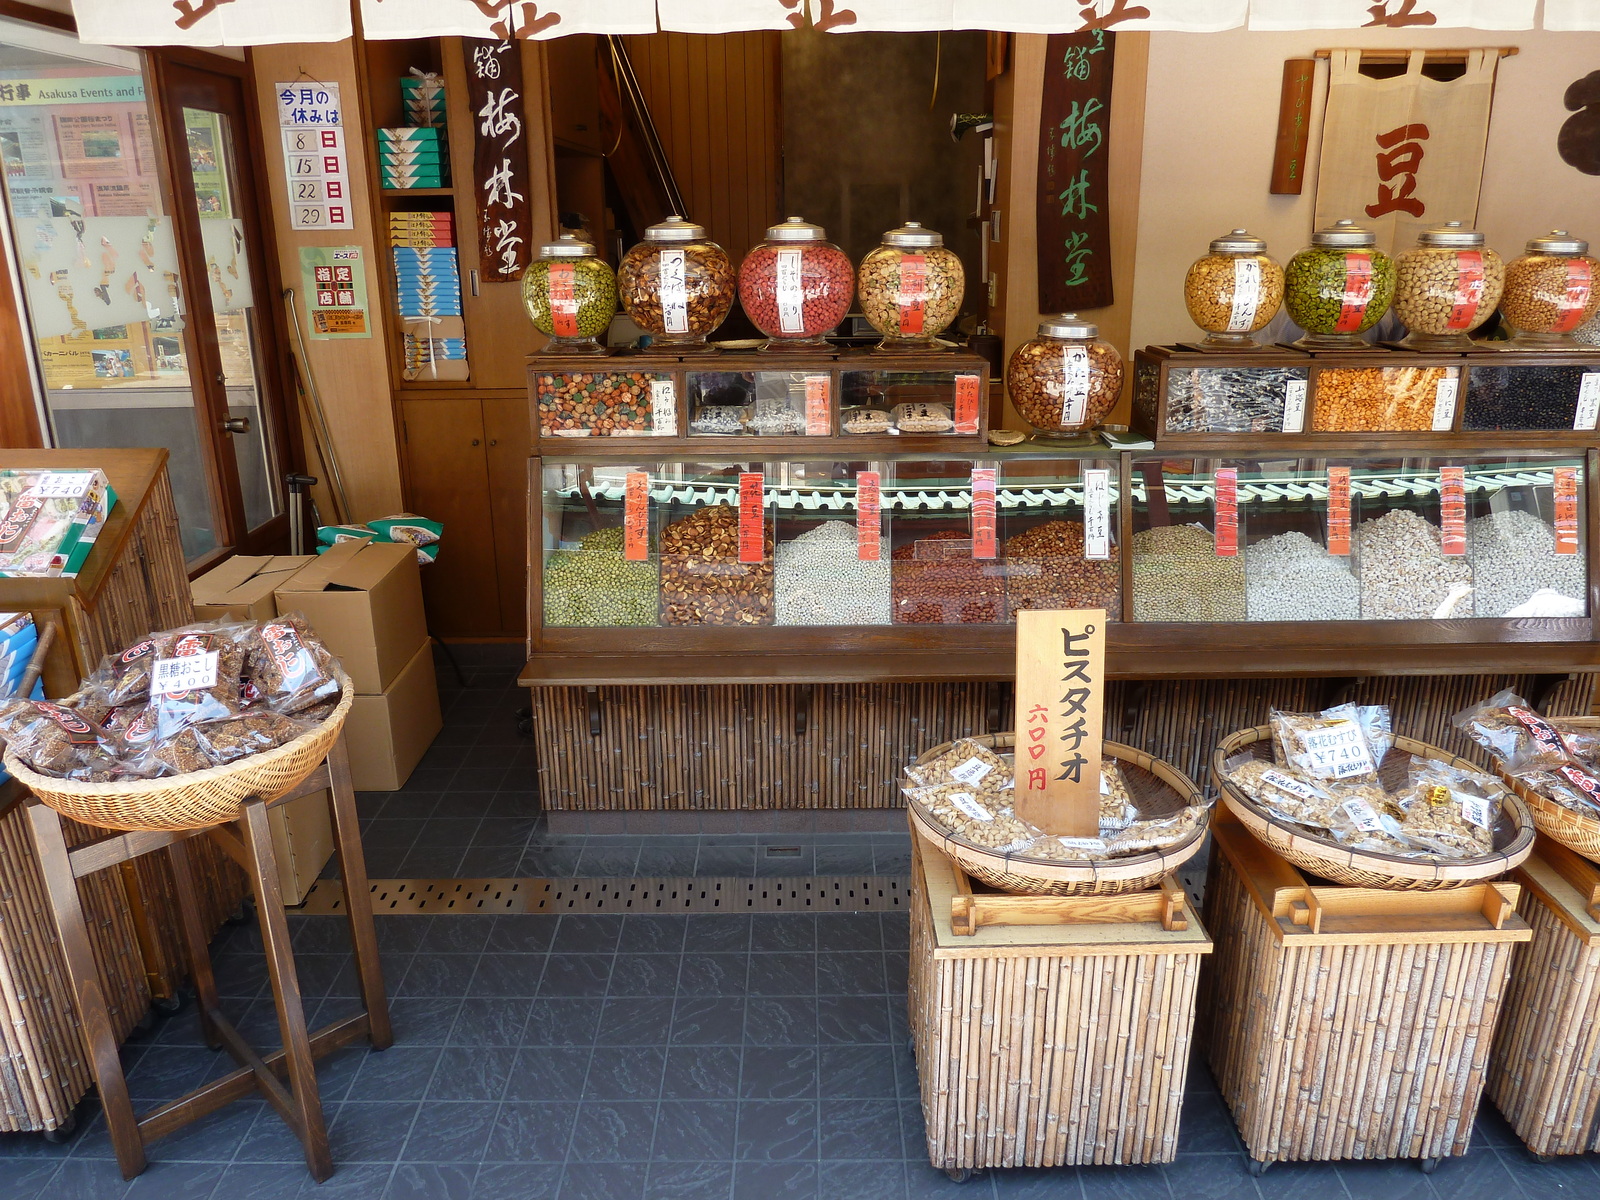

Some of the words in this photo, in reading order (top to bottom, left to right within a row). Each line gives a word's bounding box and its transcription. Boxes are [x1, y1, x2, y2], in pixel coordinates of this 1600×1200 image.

[38, 89, 78, 99] Asakusa
[80, 87, 113, 98] Events
[116, 86, 135, 97] and
[280, 89, 329, 105] 今月の
[291, 108, 339, 124] 休みは
[296, 133, 306, 149] 8
[321, 131, 337, 148] 日
[296, 158, 312, 174] 15
[323, 156, 340, 173] 日
[1365, 123, 1430, 219] 豆
[298, 183, 316, 198] 22
[326, 181, 342, 198] 日
[301, 209, 320, 224] 29
[329, 206, 345, 223] 日
[38, 485, 83, 495] ¥740
[157, 657, 214, 680] 黒糖おこし
[158, 675, 211, 691] ¥400
[1053, 623, 1097, 784] ピスタチオ
[1307, 729, 1358, 750] 落花むすび
[1314, 745, 1362, 764] ¥740
